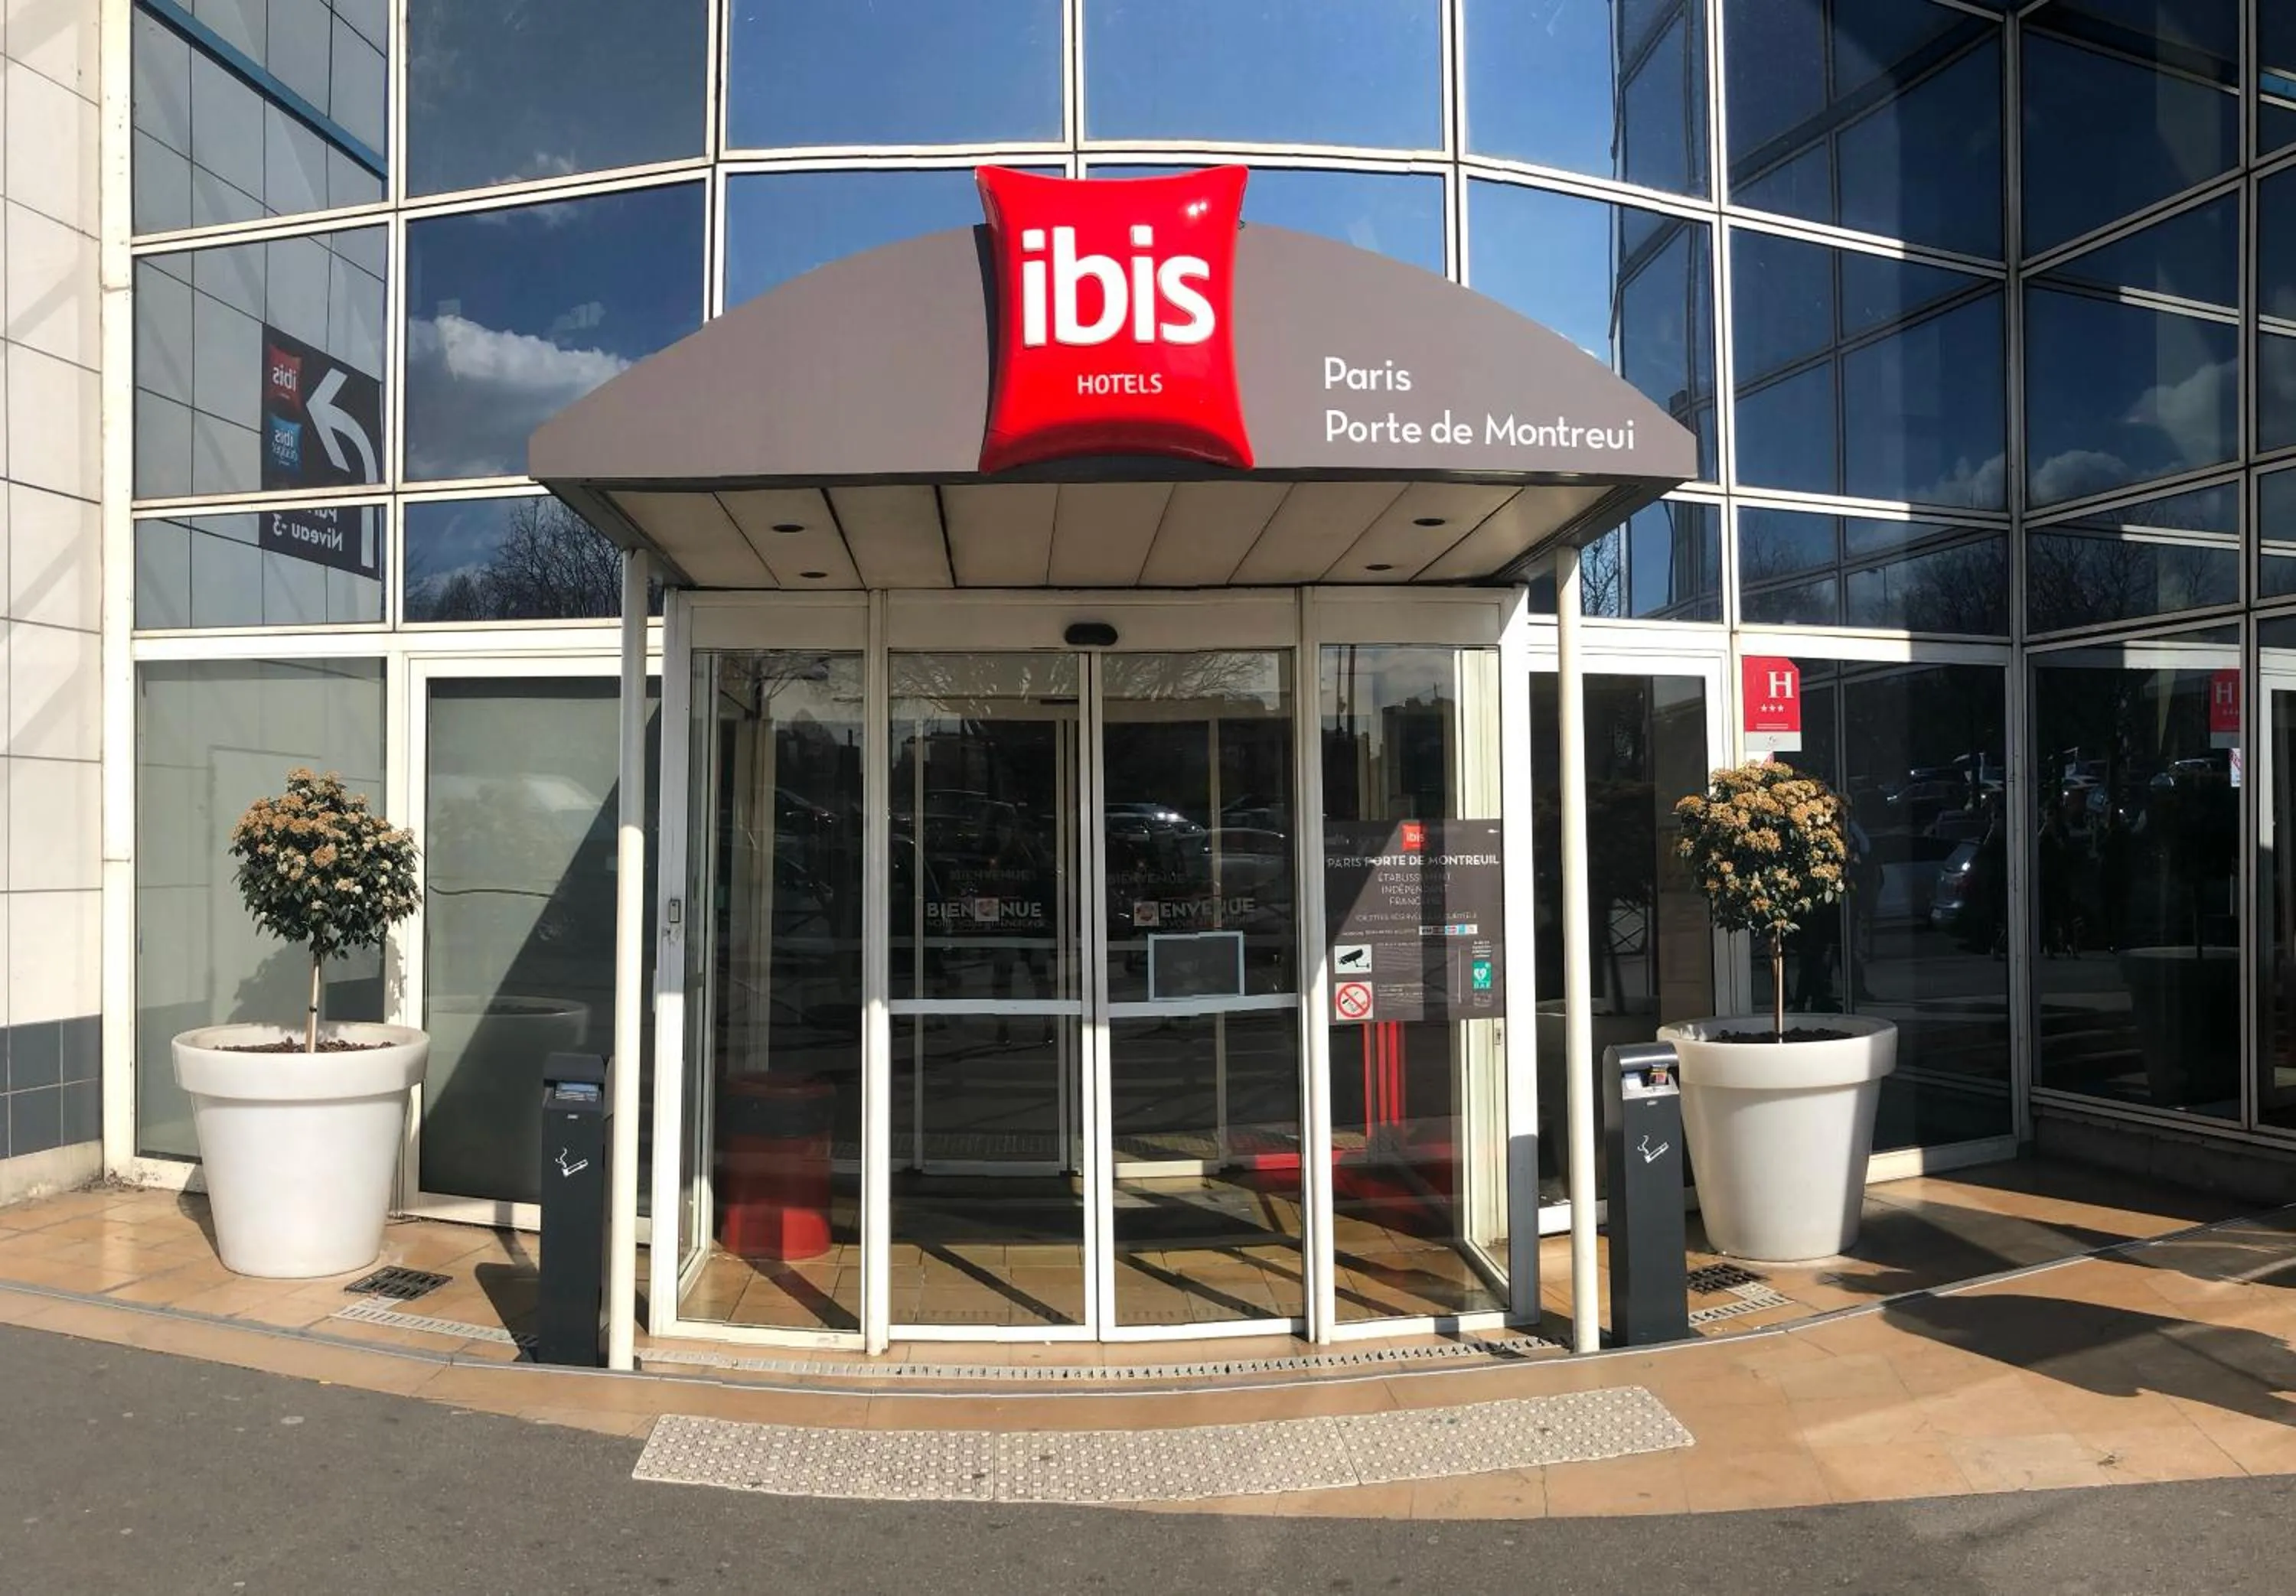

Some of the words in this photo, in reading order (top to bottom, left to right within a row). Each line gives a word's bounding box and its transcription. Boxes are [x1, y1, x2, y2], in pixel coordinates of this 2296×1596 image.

[1021, 224, 1216, 347] ibis
[1077, 373, 1163, 395] HOTELS
[1323, 357, 1412, 391] Paris
[1326, 409, 1422, 444] Porte
[1430, 409, 1473, 445] de
[1485, 412, 1635, 450] Montreui
[1766, 670, 1795, 699] H
[1326, 857, 1362, 868] PARIS
[1365, 855, 1407, 867] PORTE
[1409, 855, 1425, 866] DE
[1429, 853, 1500, 866] MONTREUIL
[926, 901, 1042, 917] BIENNUE
